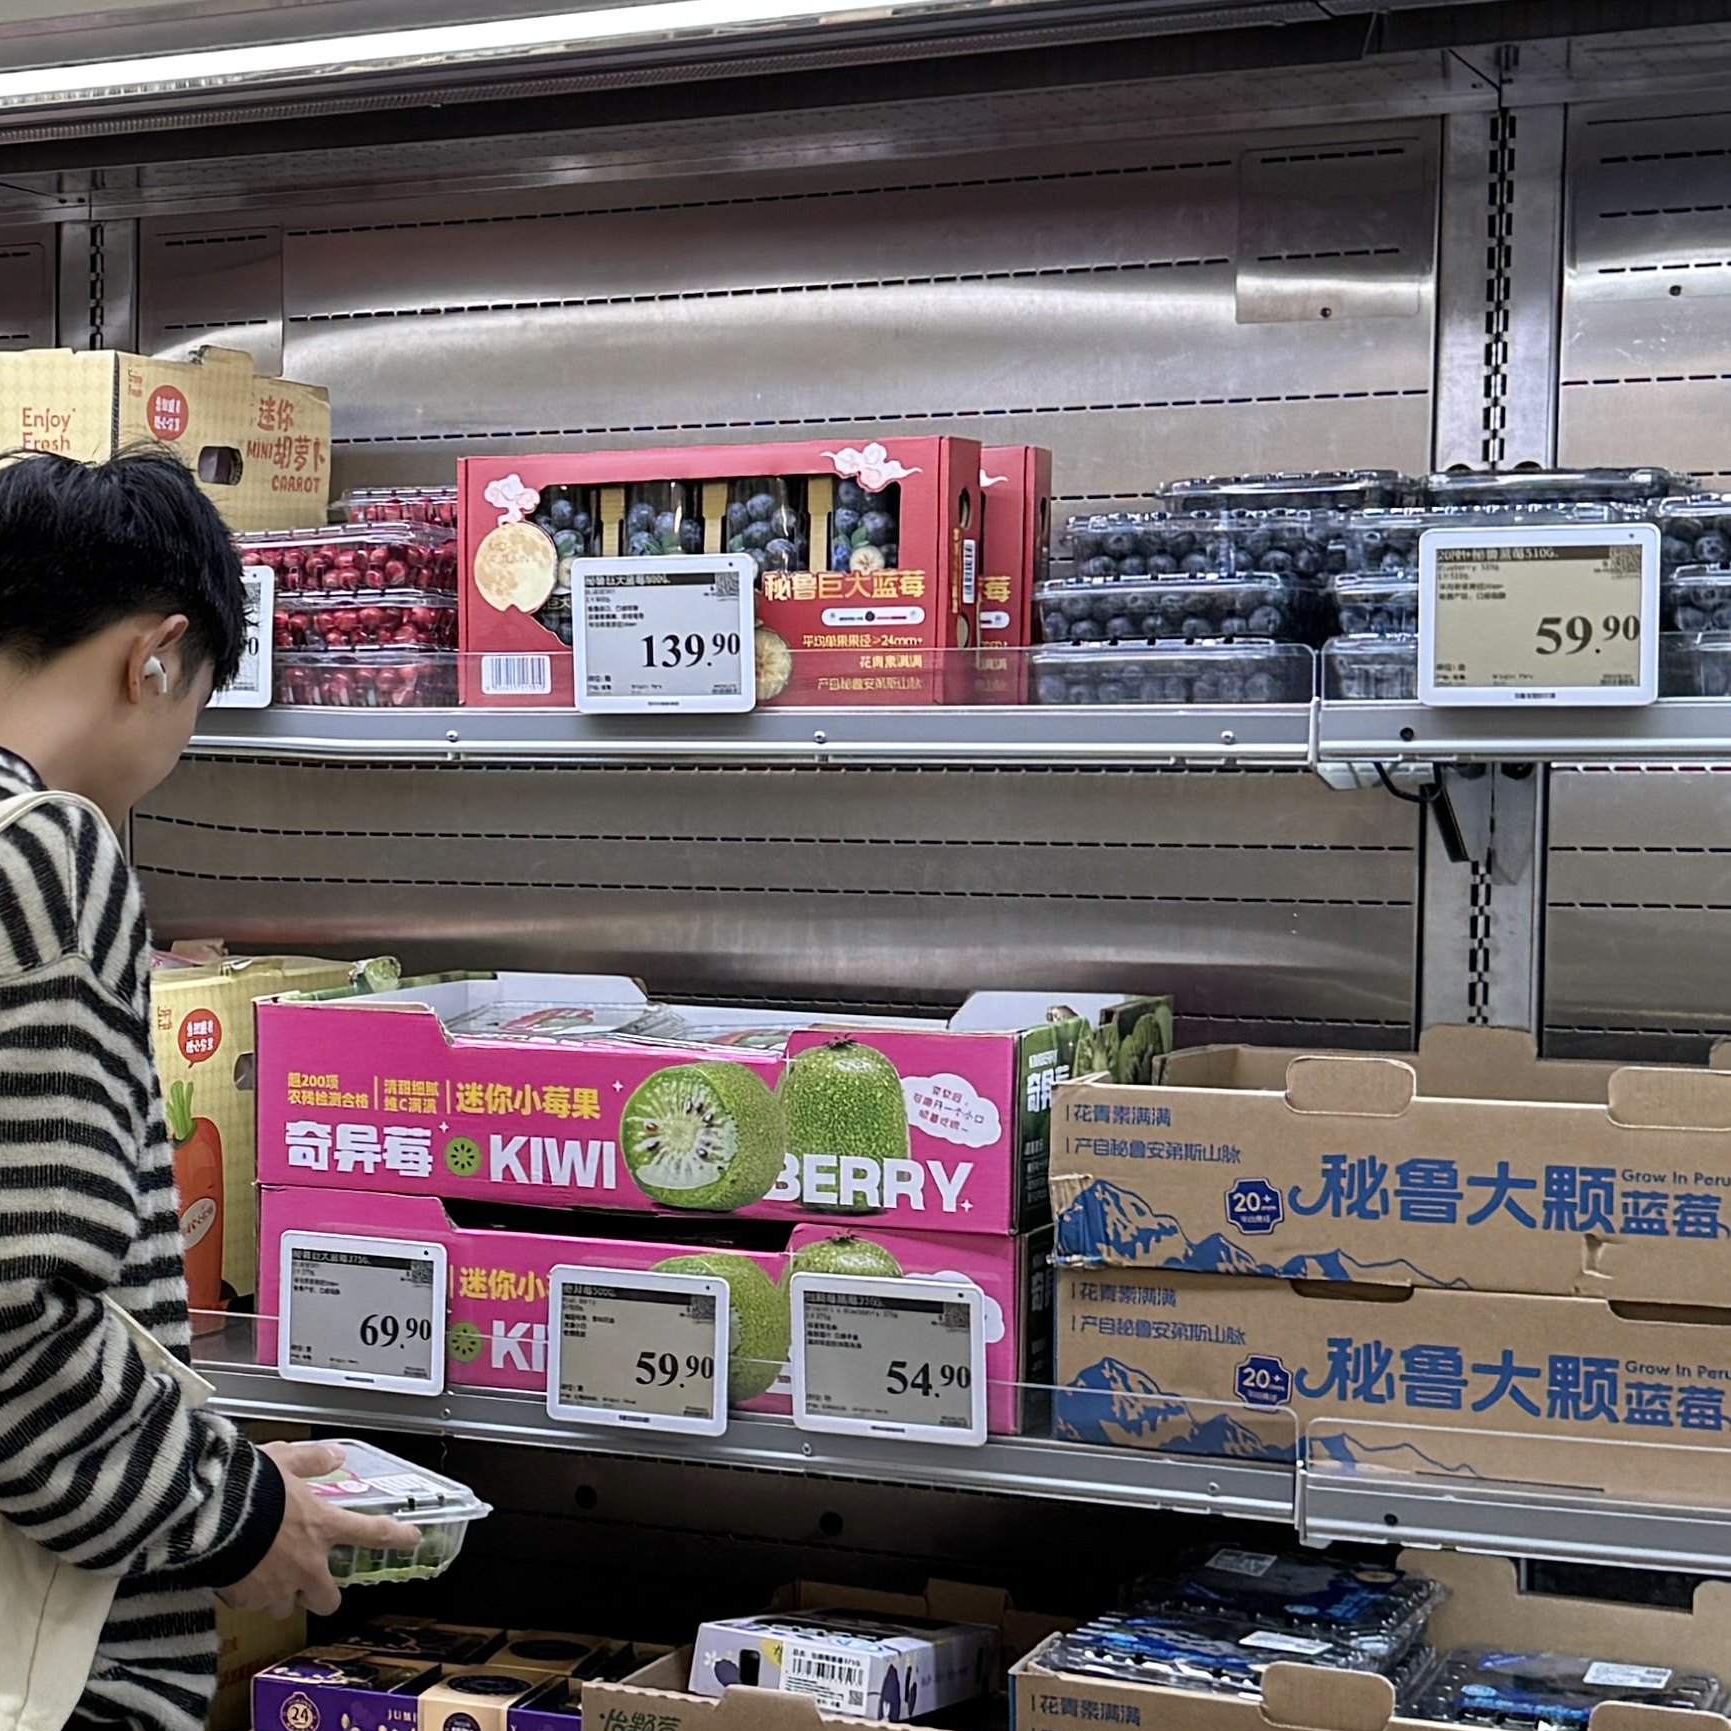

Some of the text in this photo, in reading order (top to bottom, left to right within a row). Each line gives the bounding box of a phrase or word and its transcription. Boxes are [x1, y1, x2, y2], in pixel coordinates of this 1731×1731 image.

[22, 407, 70, 432] Enjoy
[257, 395, 295, 432] 迷你
[22, 433, 70, 452] Fresh
[247, 440, 273, 460] MINI
[272, 435, 325, 472] 胡萝卜
[271, 474, 321, 493] CARROT
[764, 571, 925, 601] 秘鲁巨大蓝莓
[641, 632, 740, 668] 139.90
[1535, 615, 1641, 655] 59.90
[456, 1081, 601, 1120] 迷你小莓果
[1073, 1103, 1171, 1127] 花青素满满
[285, 1120, 433, 1178] 奇异莓
[489, 1134, 616, 1190] KIWI
[762, 1153, 974, 1213] BERRY
[1621, 1168, 1731, 1187] Grow In Peru
[1289, 1153, 1731, 1239] 秘鲁大颗蓝莓
[459, 1266, 547, 1303] 迷你小
[1078, 1281, 1176, 1307] 花青素满满
[360, 1314, 432, 1349] 69.90
[635, 1351, 714, 1388] 59.90
[886, 1360, 971, 1398] 54.90
[1295, 1337, 1731, 1431] 秘鲁大颗蓝莓
[1625, 1360, 1731, 1380] Grow In Peru
[1039, 1693, 1141, 1727] 花青素满满
